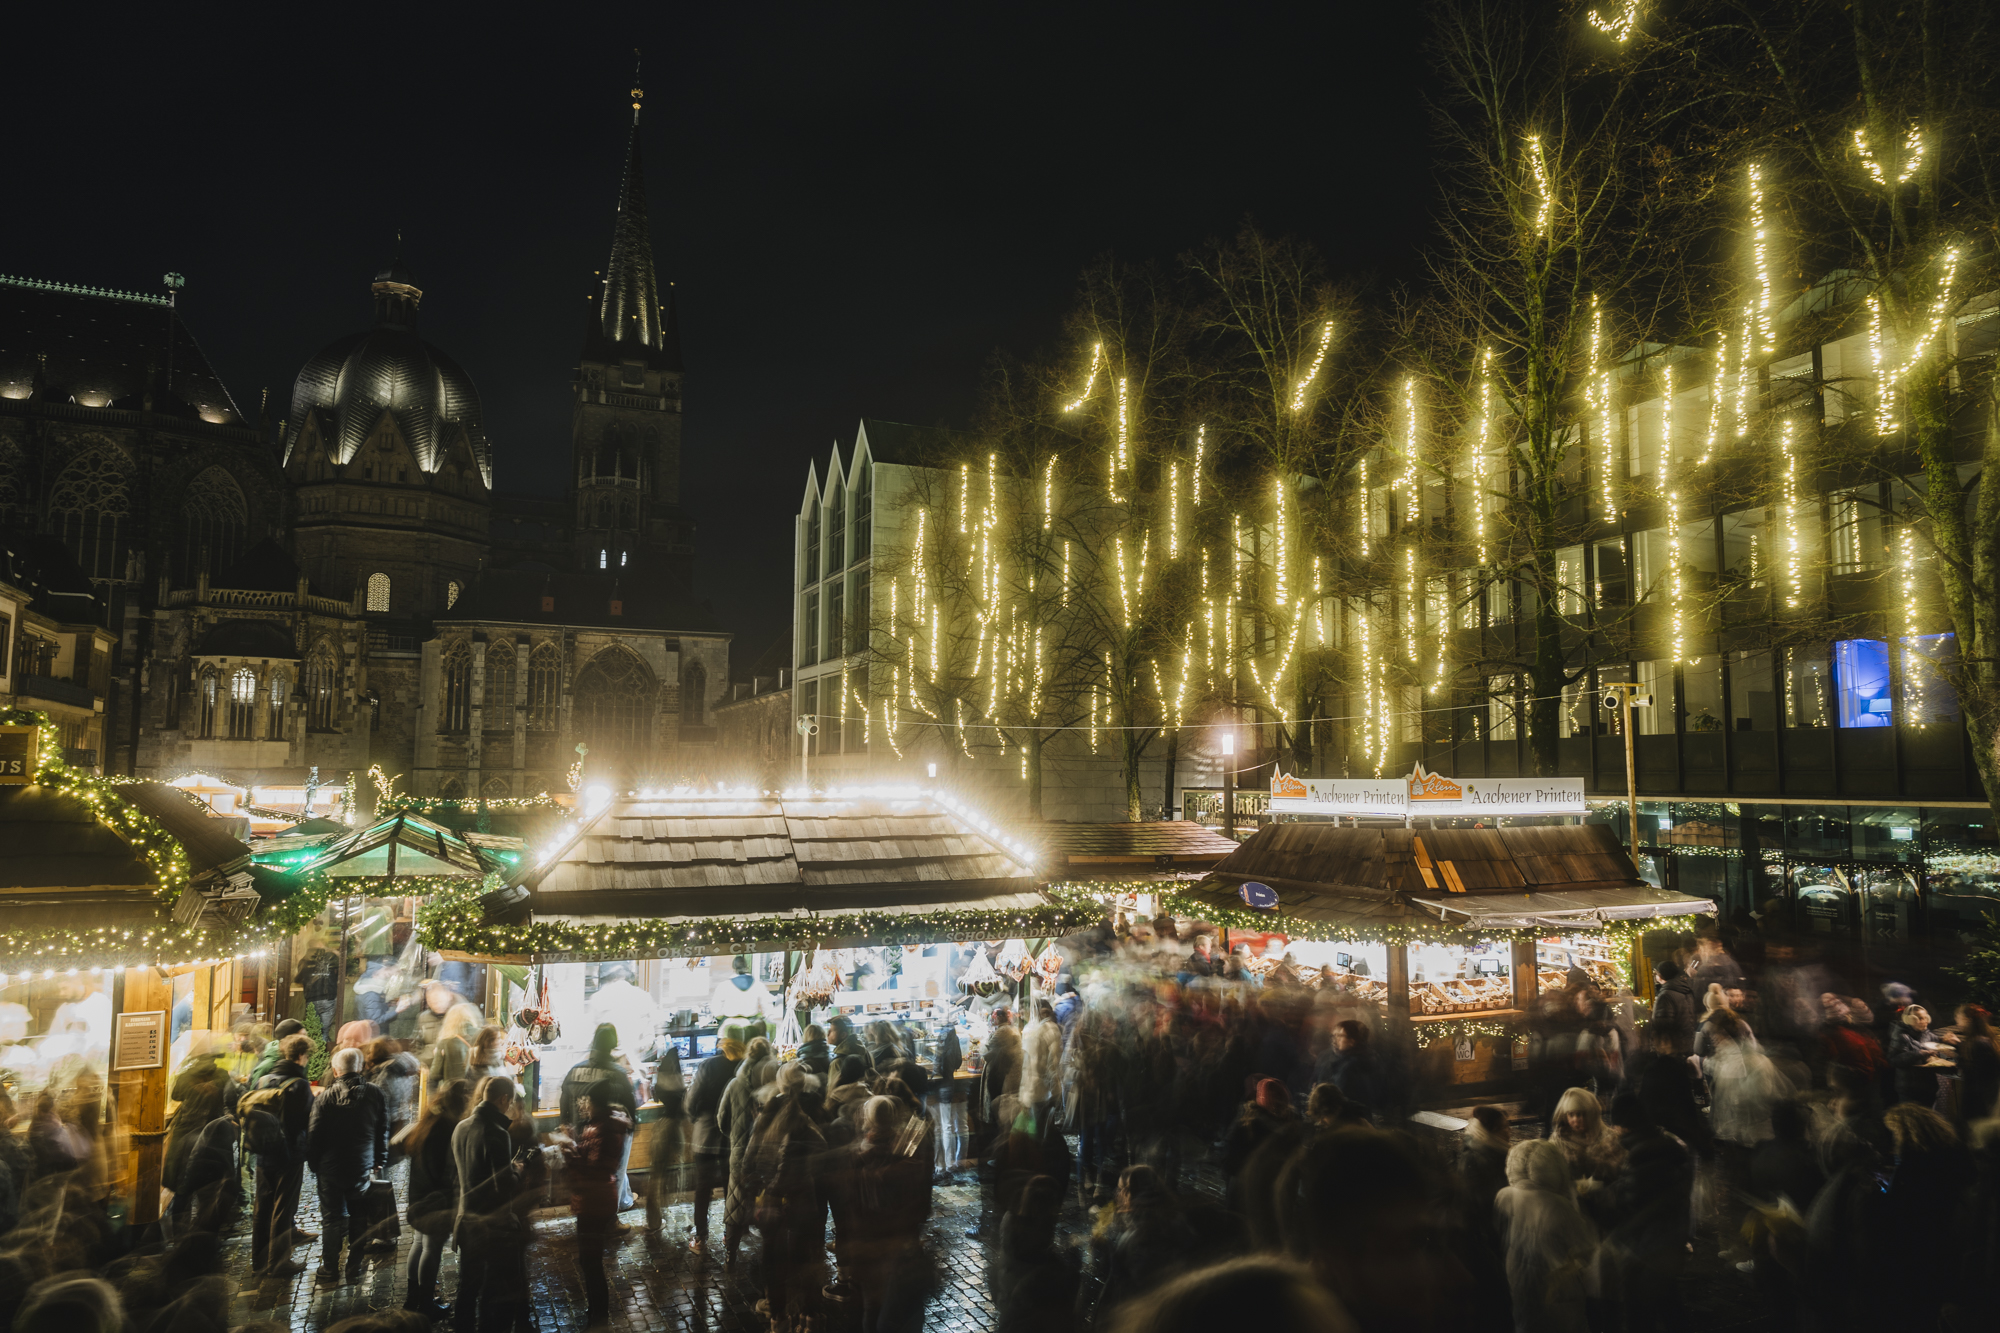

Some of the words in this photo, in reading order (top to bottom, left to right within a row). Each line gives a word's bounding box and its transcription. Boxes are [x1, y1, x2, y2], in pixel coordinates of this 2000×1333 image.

[1313, 783, 1360, 805] Aachener
[1363, 788, 1405, 805] Printen
[1471, 783, 1531, 806] Aachener
[1535, 787, 1582, 803] Printen
[656, 945, 706, 959] OBST
[945, 926, 1061, 942] SCHOKOLADEN
[1457, 1050, 1470, 1059] WC
